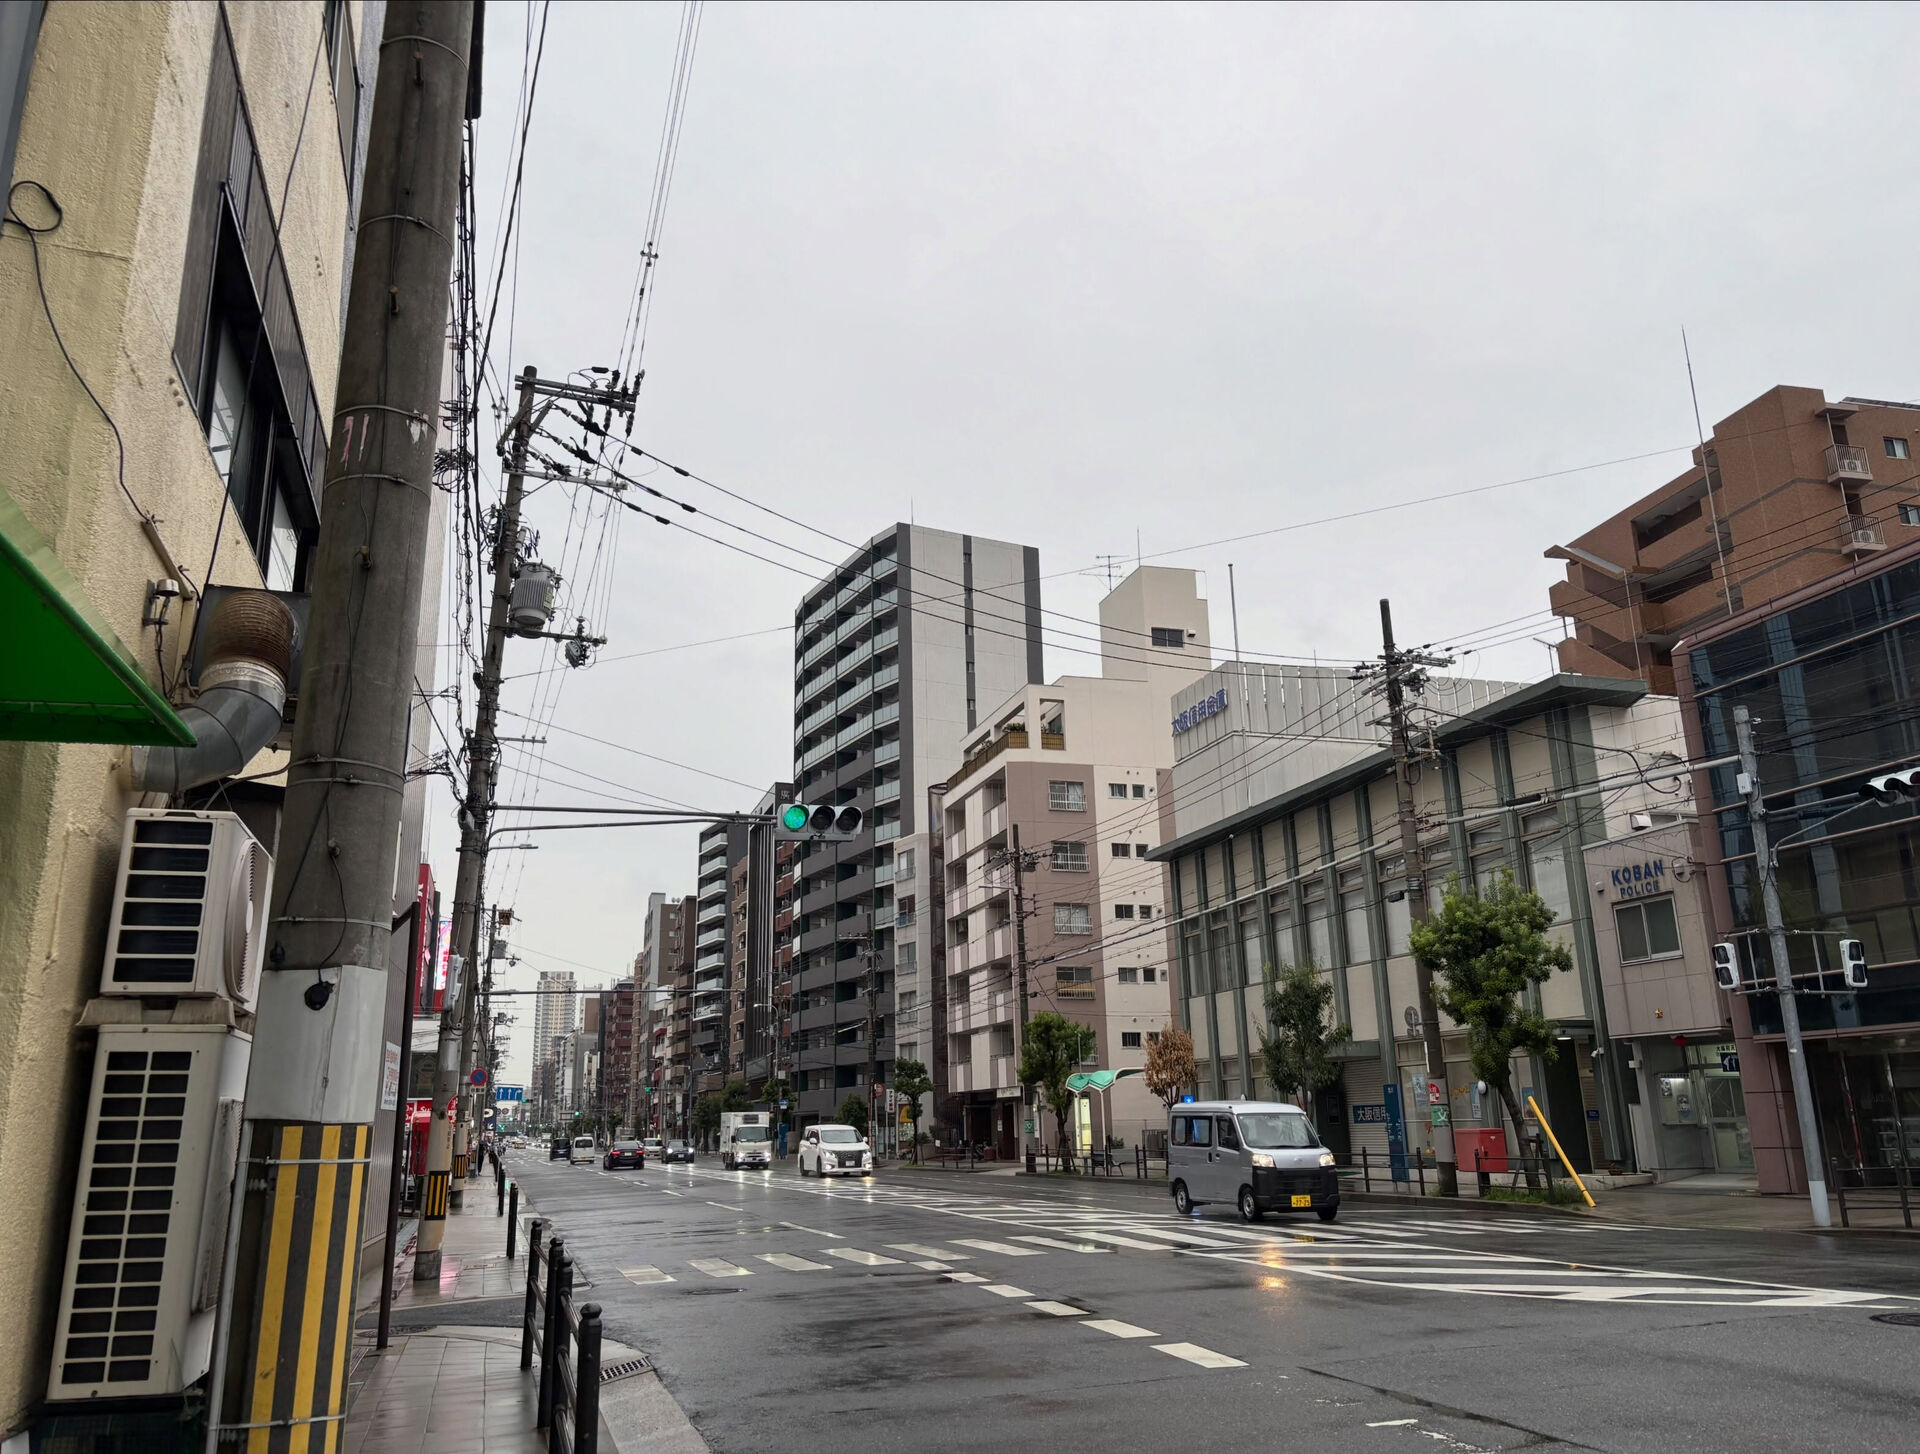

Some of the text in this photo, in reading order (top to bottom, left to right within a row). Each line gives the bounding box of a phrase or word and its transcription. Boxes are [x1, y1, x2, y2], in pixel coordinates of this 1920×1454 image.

[1171, 688, 1228, 737] 大阪信用金庫
[1611, 859, 1664, 886] KOBAN
[1620, 880, 1660, 899] POLICE
